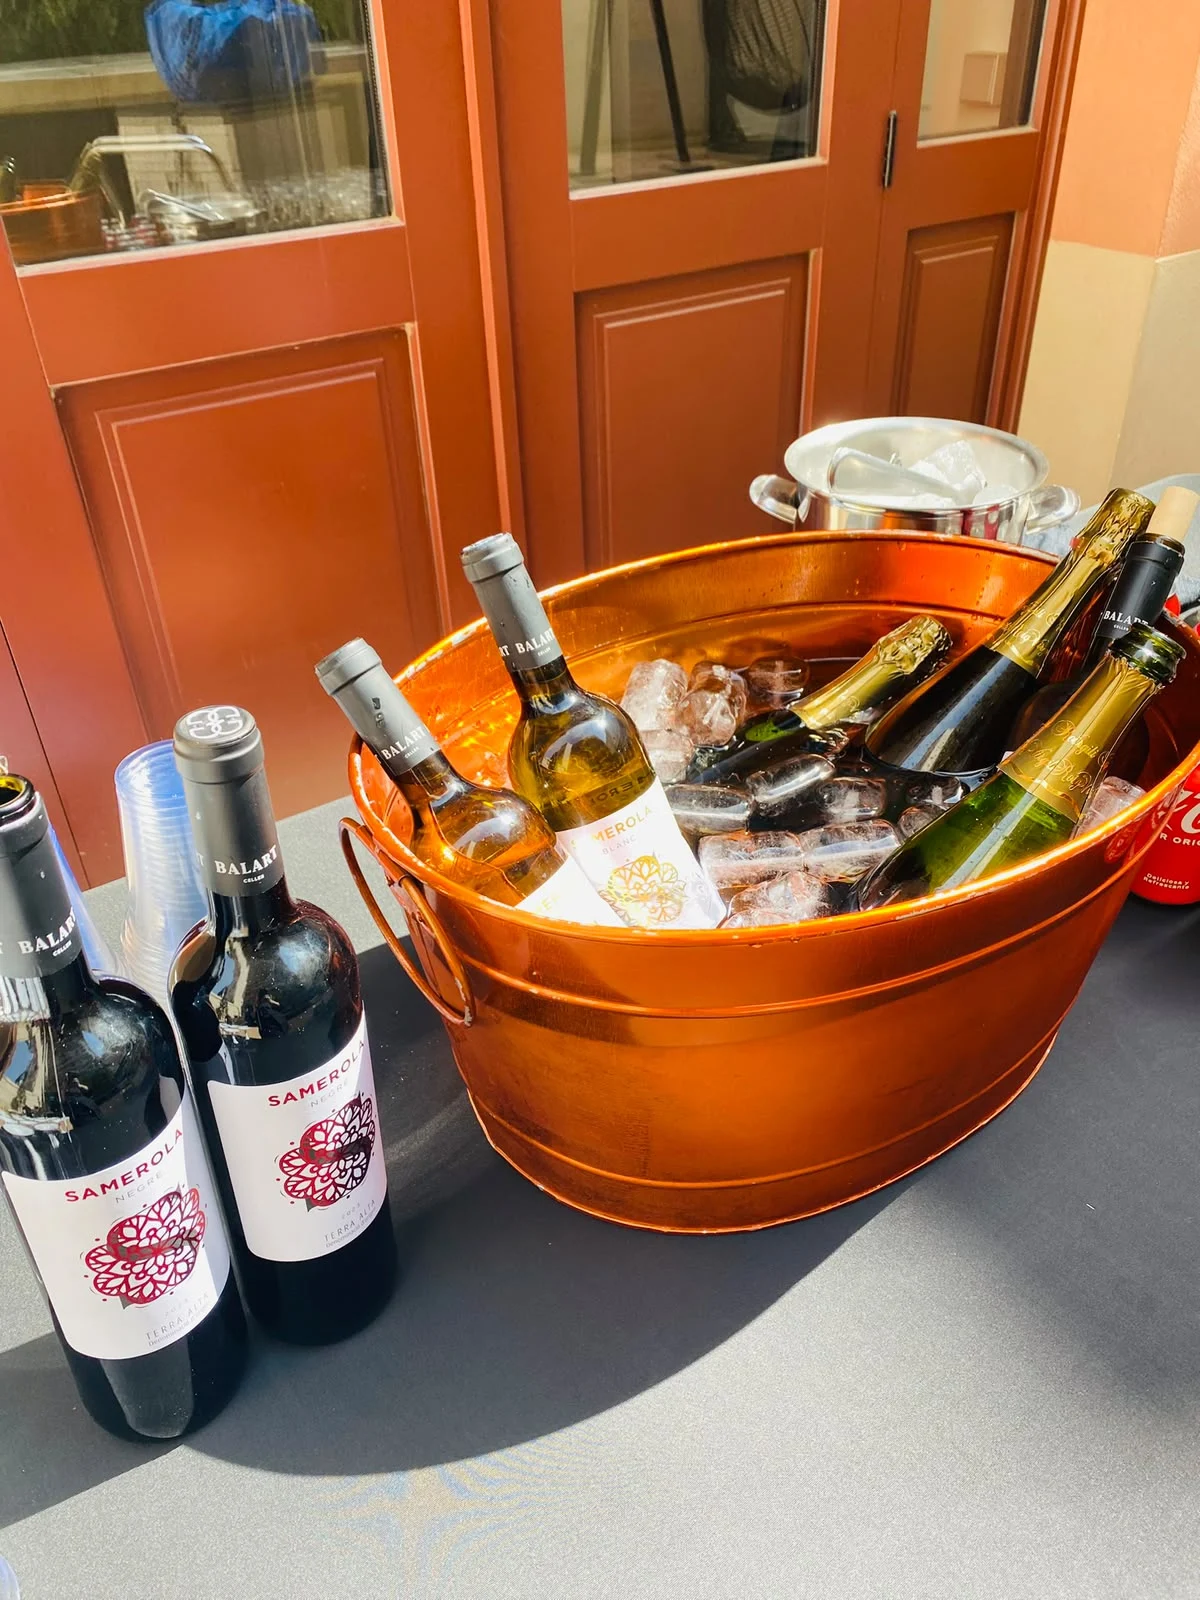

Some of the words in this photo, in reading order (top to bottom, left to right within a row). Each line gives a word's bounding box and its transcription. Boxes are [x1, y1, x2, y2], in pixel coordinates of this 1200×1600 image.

[381, 726, 426, 760] BALART
[214, 844, 278, 875] BALART
[242, 873, 265, 884] CELLER
[267, 1040, 365, 1108] SAMEROLA
[310, 1077, 349, 1108] NEGRE
[64, 1128, 183, 1203] SAMEROLA
[115, 1170, 164, 1204] NEGRE
[325, 1220, 355, 1242] TERRA
[146, 1316, 183, 1341] TERRA
